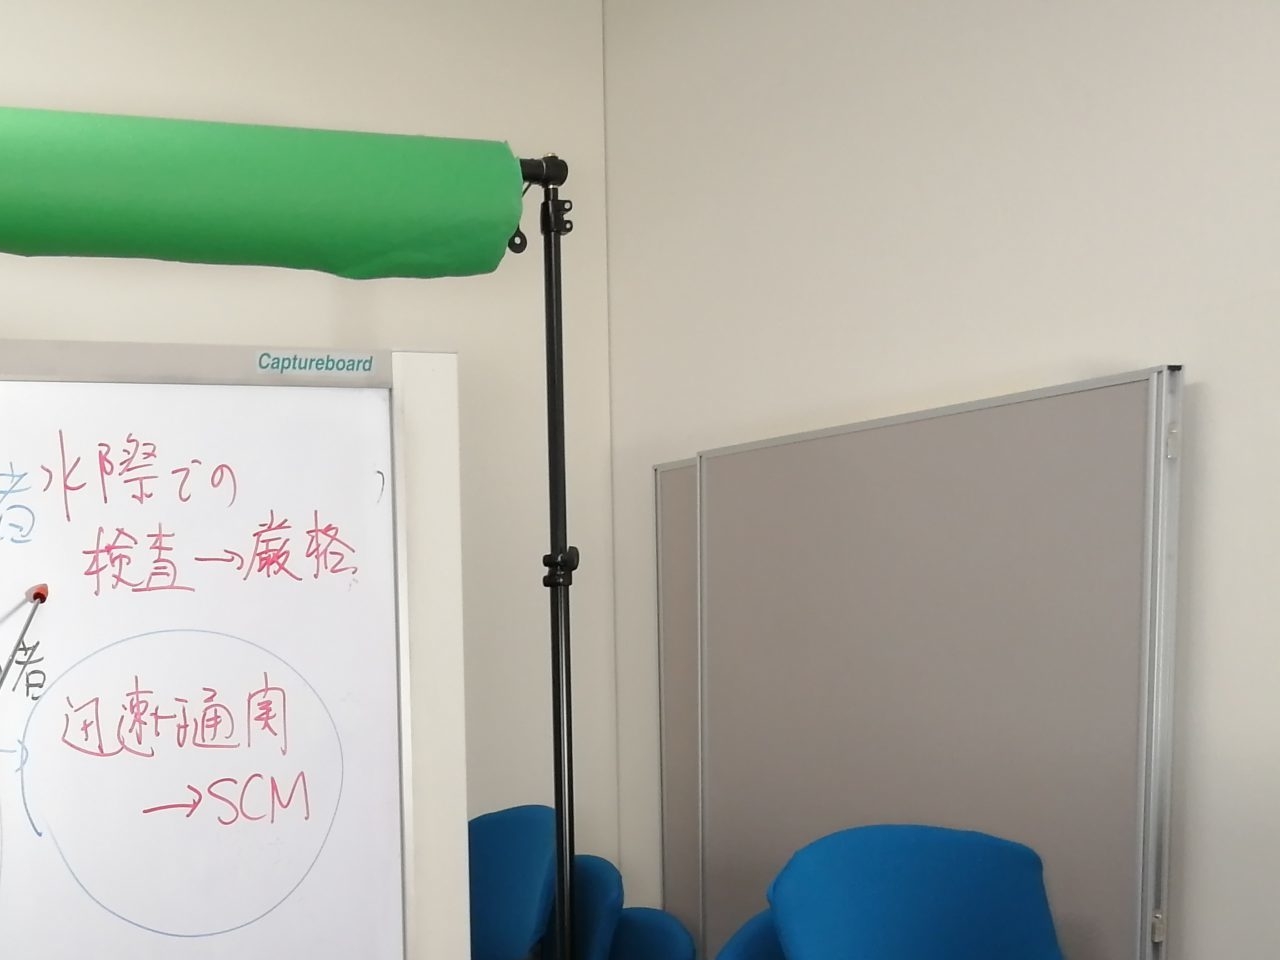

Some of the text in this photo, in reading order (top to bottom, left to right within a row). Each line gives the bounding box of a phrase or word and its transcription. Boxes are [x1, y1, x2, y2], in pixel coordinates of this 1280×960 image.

[257, 352, 373, 374] Captureboard
[40, 429, 237, 523] 水際での
[206, 770, 310, 826] SCM
